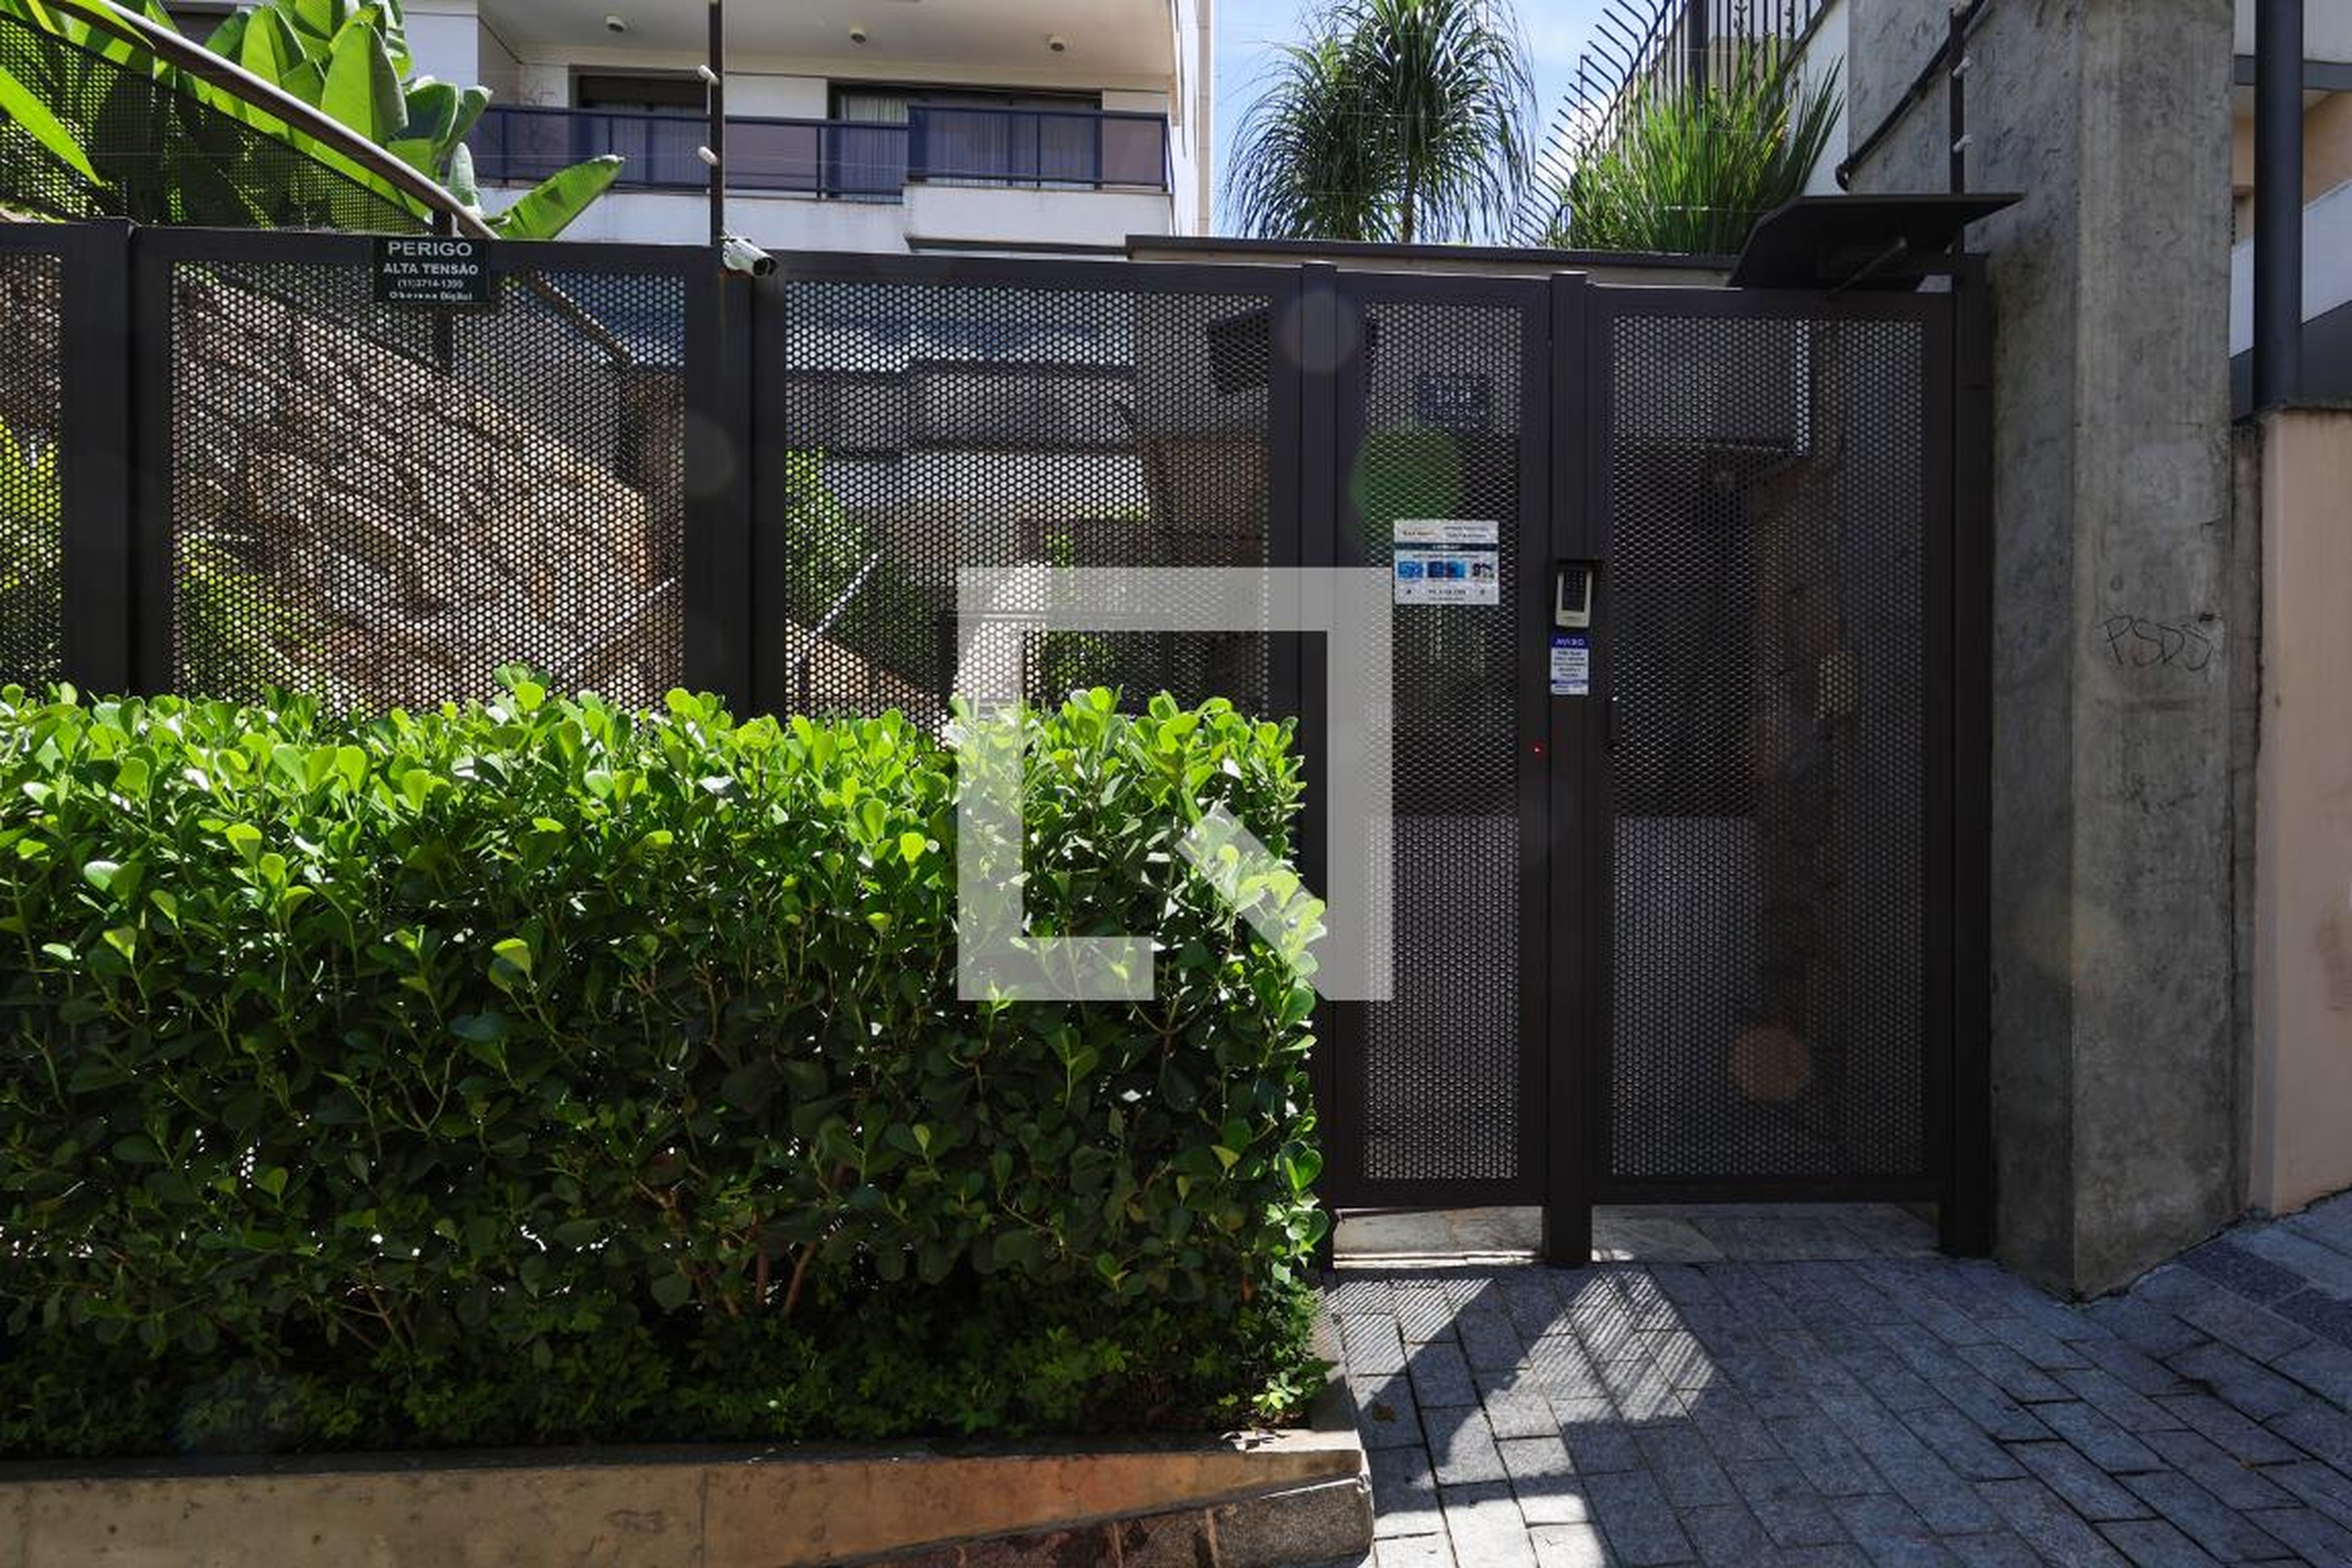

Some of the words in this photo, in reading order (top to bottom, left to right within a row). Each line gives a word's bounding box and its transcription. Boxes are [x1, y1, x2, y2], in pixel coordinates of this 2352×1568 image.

[388, 241, 472, 256] PERIGO
[383, 263, 418, 274] ALTA
[422, 262, 478, 275] TENSÃO
[1555, 638, 1585, 646] AVISO
